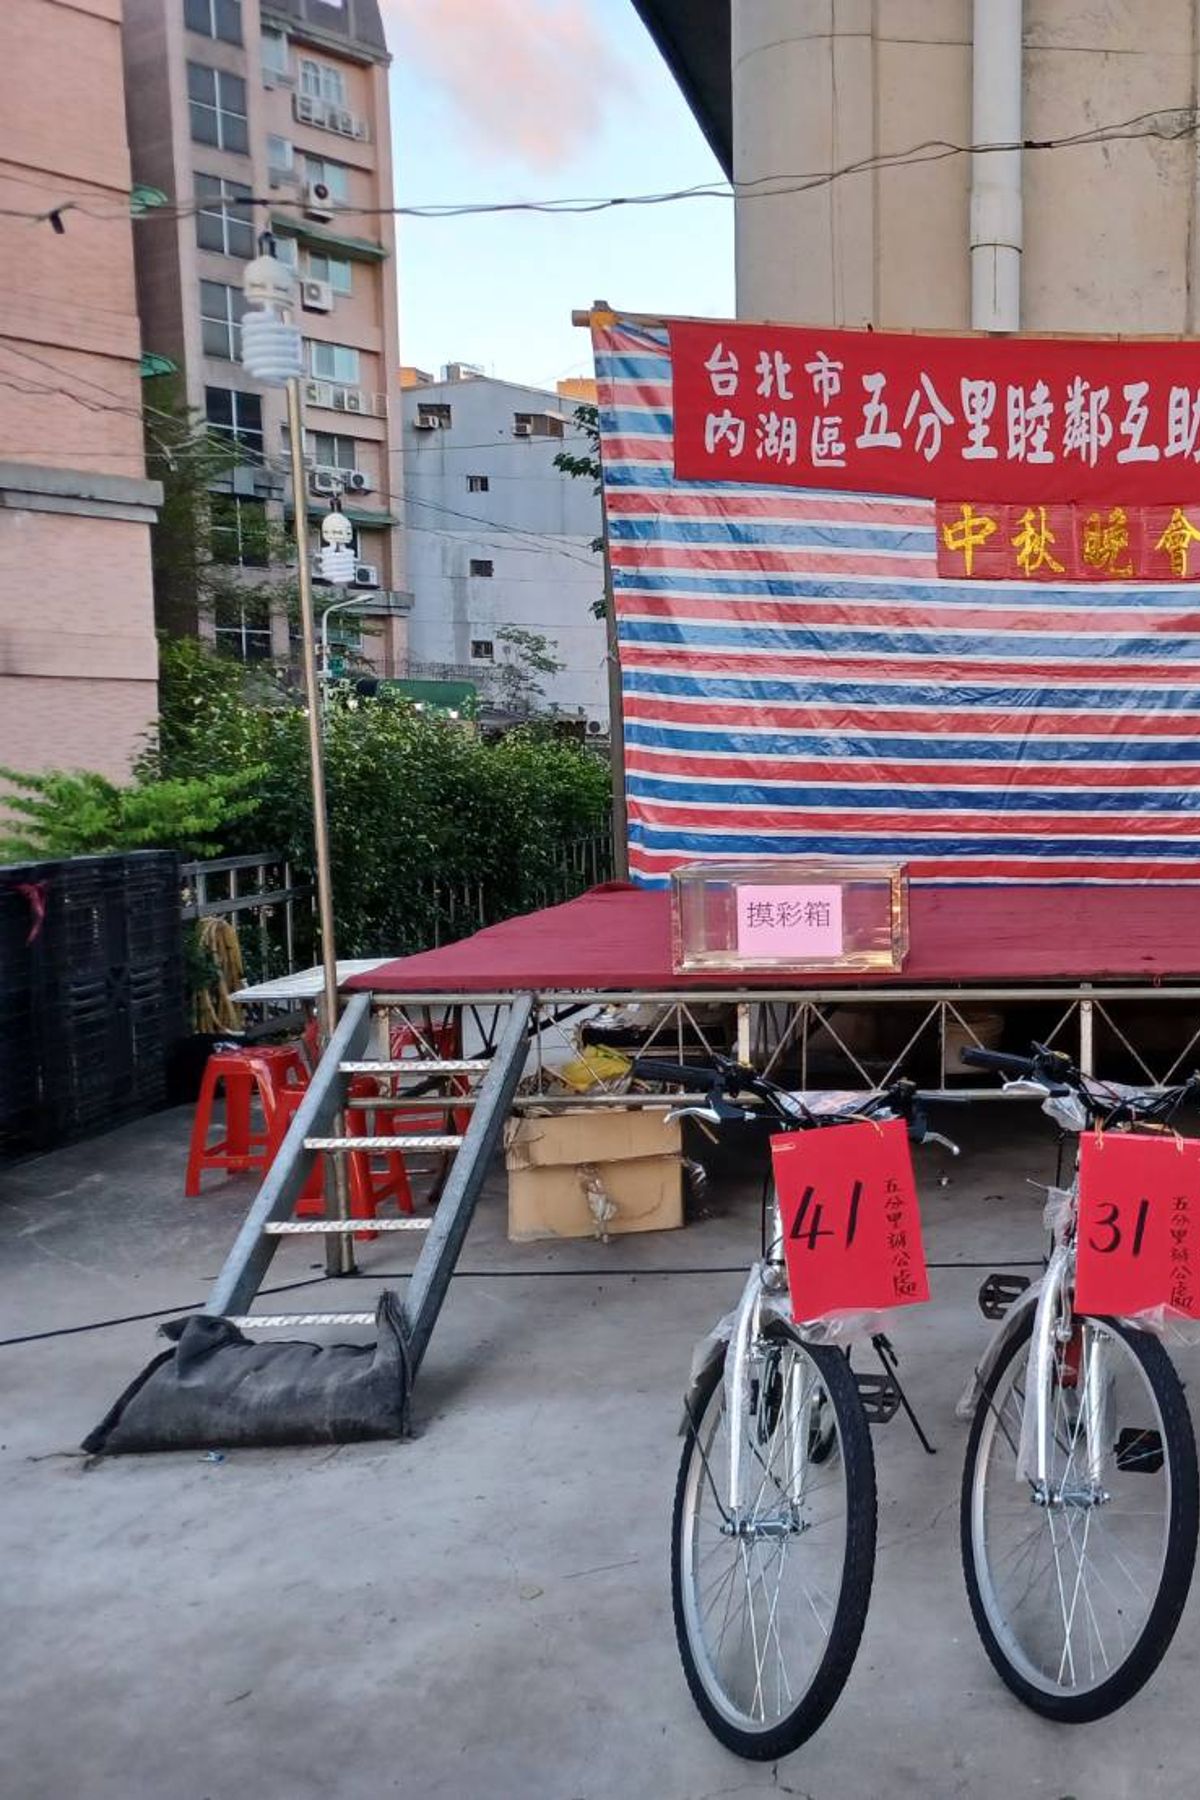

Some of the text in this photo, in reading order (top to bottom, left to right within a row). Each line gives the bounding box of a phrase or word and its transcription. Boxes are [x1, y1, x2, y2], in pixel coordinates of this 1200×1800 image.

[703, 341, 845, 408] 台北市
[746, 901, 831, 928] 摸彩箱
[789, 1179, 864, 1251] 41
[1088, 1197, 1150, 1257] 31
